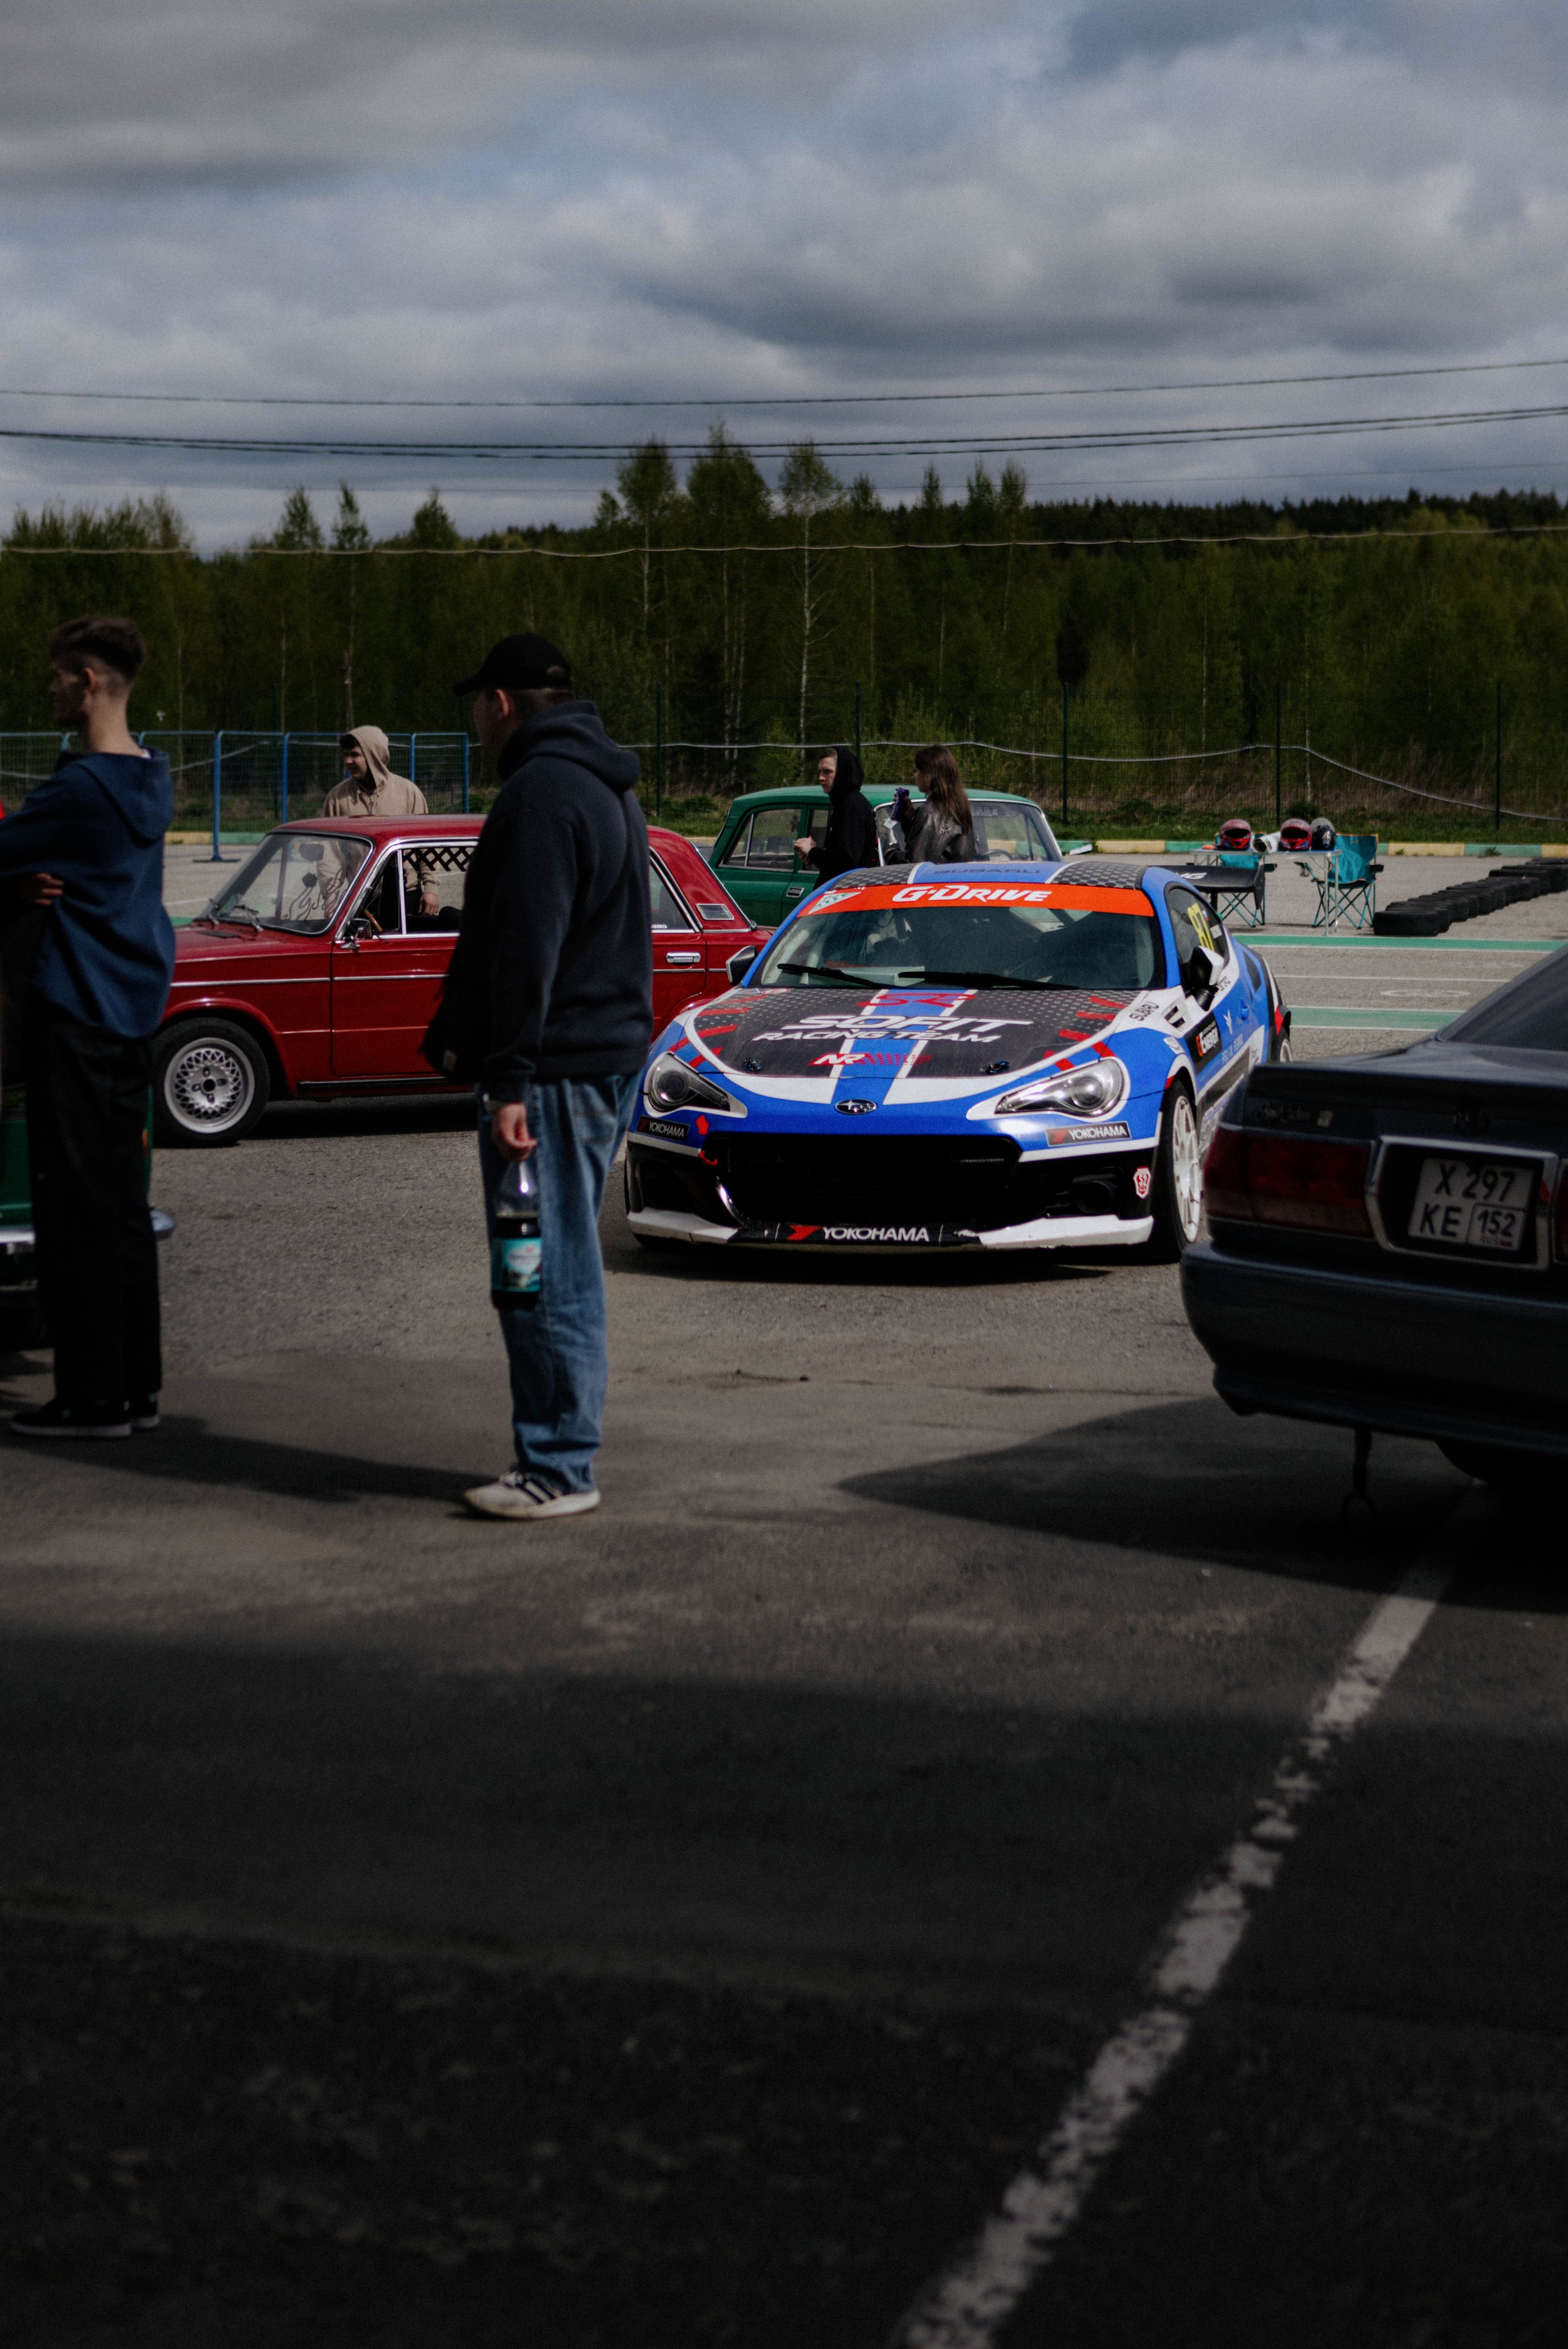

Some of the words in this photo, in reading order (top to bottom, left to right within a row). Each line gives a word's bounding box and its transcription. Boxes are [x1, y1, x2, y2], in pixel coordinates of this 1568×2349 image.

[752, 1031, 890, 1042] RACING
[893, 1031, 1002, 1043] TEAM
[649, 1121, 685, 1138] YOKOHAMA
[1068, 1125, 1127, 1140] YOKOHAMA
[1461, 1168, 1515, 1202] 297
[1477, 1209, 1516, 1236] 152
[823, 1227, 930, 1242] YOKOHAMA
